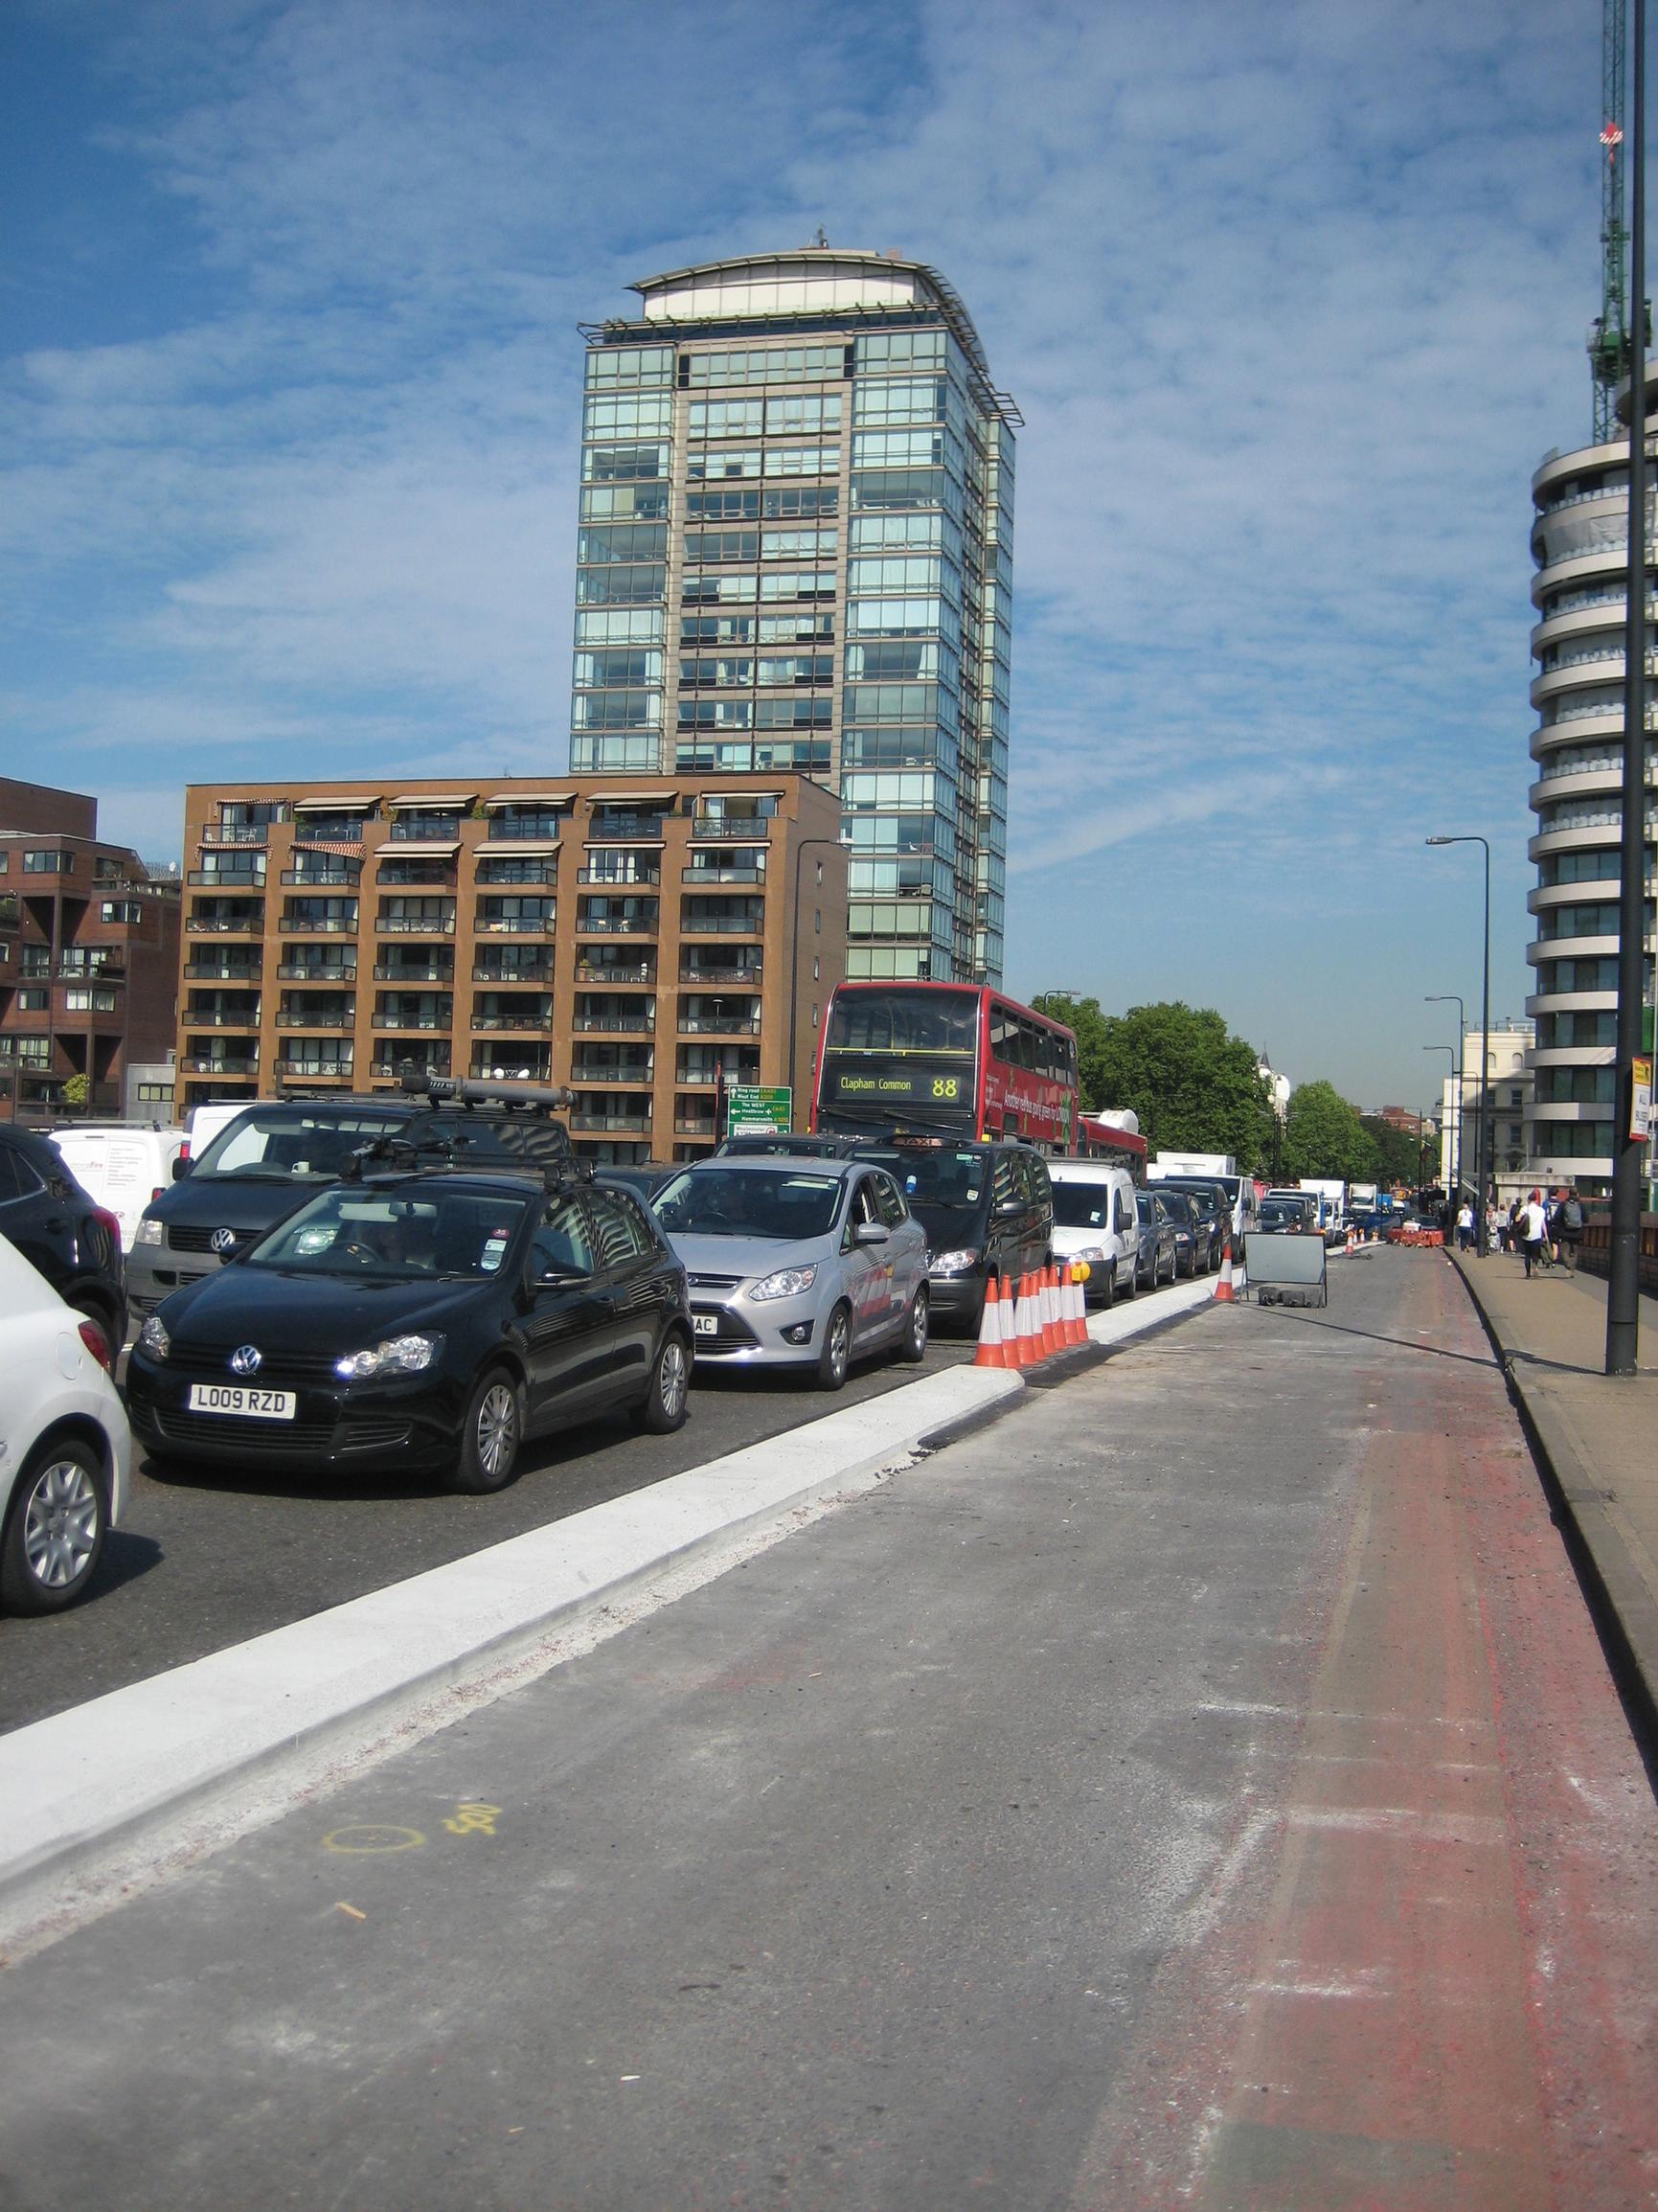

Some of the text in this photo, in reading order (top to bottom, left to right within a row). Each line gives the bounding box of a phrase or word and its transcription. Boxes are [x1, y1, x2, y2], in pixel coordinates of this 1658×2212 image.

[841, 1077, 911, 1091] Clapham Common
[932, 1079, 957, 1097] 88
[197, 1387, 285, 1412] LO09 RZD
